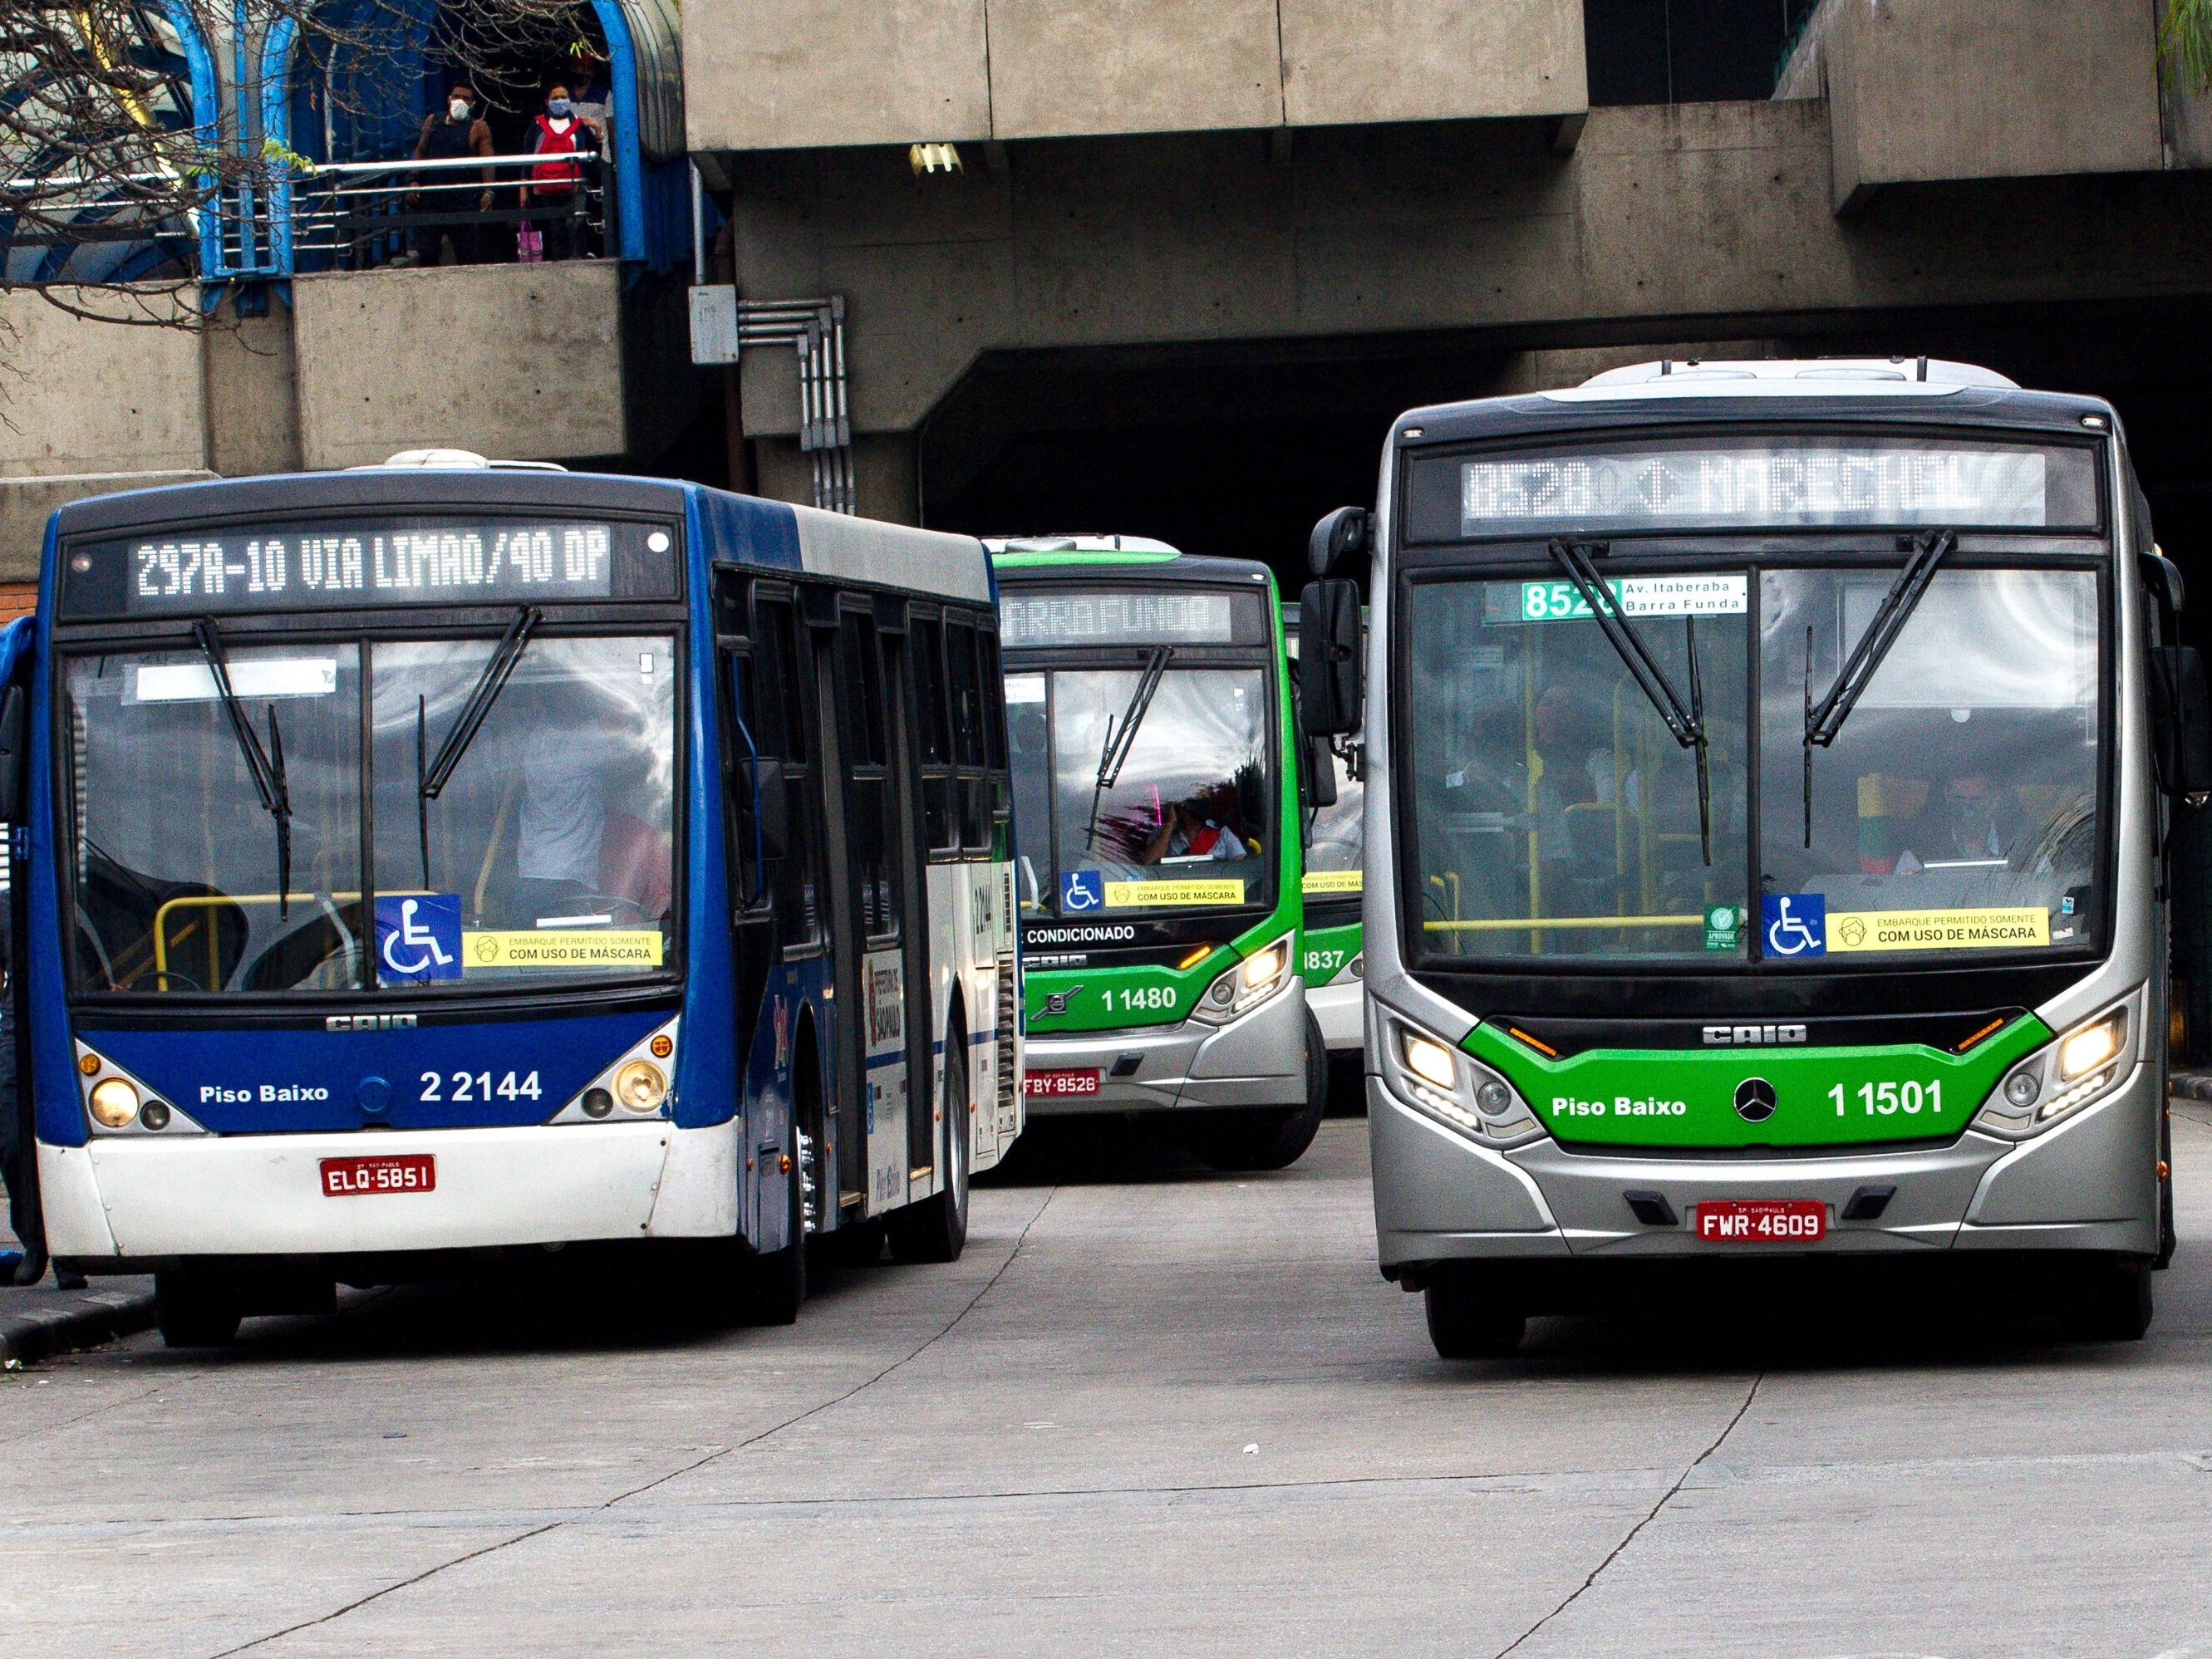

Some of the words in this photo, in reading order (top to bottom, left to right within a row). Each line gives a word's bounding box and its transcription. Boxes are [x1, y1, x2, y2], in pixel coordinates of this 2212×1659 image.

[1700, 454, 1982, 512] MARECHAL
[137, 541, 287, 596] 297A-10
[301, 538, 363, 590] VIA
[374, 532, 553, 588] LIMAO/90
[564, 530, 607, 582] DP
[1625, 582, 1649, 594] Av.
[1654, 582, 1730, 593] Itaberaba
[1625, 601, 1676, 611] Barra
[1684, 599, 1739, 610] Funda
[1000, 601, 1093, 636] ARRA
[1099, 596, 1210, 633] FUNDA
[1138, 893, 1158, 901] COM
[1160, 892, 1178, 901] USO
[1193, 891, 1236, 900] MÁSCARA
[1877, 917, 1931, 927] EMBARQUE
[1934, 915, 1987, 925] PERMITIDO
[1991, 915, 2036, 925] SOMENTE
[509, 937, 558, 946] EMBARQUE
[559, 937, 607, 945] PERMITIDO
[610, 937, 651, 945] SOMENTE
[1027, 925, 1135, 944] CONDICIONADO
[1878, 930, 1910, 943] COM
[1914, 929, 1943, 941] USO
[1947, 928, 1965, 940] DE
[1969, 925, 2037, 940] MÁSCARA
[509, 949, 538, 960] COM
[541, 949, 568, 959] USO
[571, 948, 587, 959] DE
[590, 946, 651, 959] MÁSCARA
[1101, 990, 1113, 1012] 1
[1119, 987, 1177, 1010] 1480
[326, 1014, 418, 1032] CAIO
[1702, 1024, 1806, 1043] CAIO
[199, 1086, 252, 1103] Piso
[259, 1084, 329, 1102] Baixo
[420, 1072, 441, 1102] 2
[451, 1071, 543, 1102] 2144
[1551, 1097, 1606, 1117] Piso
[1615, 1096, 1687, 1116] Baixo
[1828, 1083, 1844, 1117] 1
[1857, 1079, 1942, 1116] 1501
